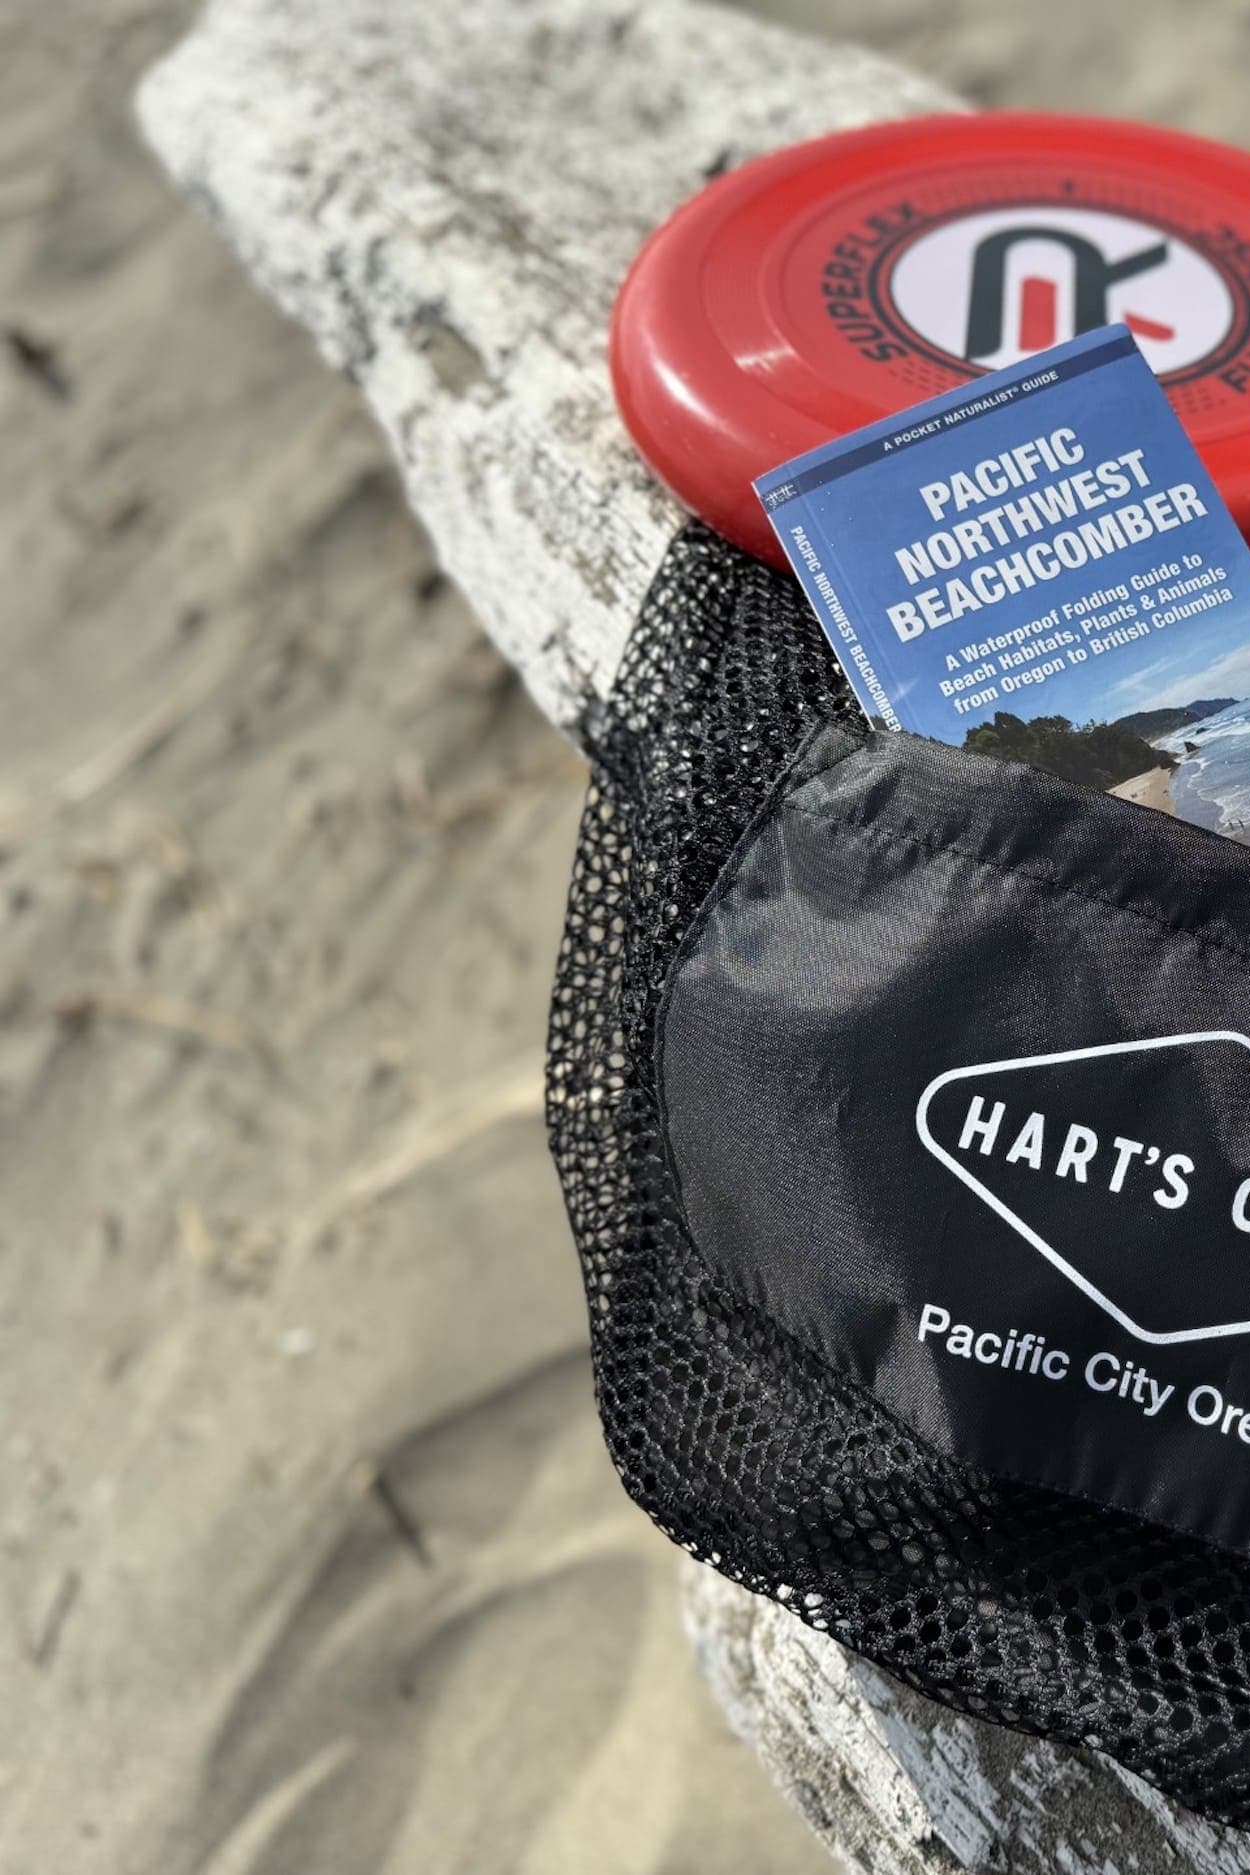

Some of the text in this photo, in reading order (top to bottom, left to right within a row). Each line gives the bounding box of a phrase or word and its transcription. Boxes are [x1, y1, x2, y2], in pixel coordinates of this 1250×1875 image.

[821, 203, 918, 362] SUPERFLEX
[883, 441, 893, 451] A
[894, 420, 942, 447] POCKET
[1021, 370, 1060, 392] GUIDE
[919, 427, 1085, 522] PACIFIC
[886, 483, 1208, 643] BEACHCOMBER
[894, 448, 1151, 586] NORTHWEST
[790, 525, 902, 733] PACIFIC NORTHWEST BEACHCOMBER
[939, 565, 1228, 698] Beach Habitats, Plants & Animals
[944, 552, 1203, 672] A Waterproof Folding Guide to
[953, 587, 1234, 715] from Oregon to British Columbia
[958, 1095, 1196, 1210] HART'S
[917, 1303, 1070, 1381] Pacific
[1084, 1352, 1175, 1418] City
